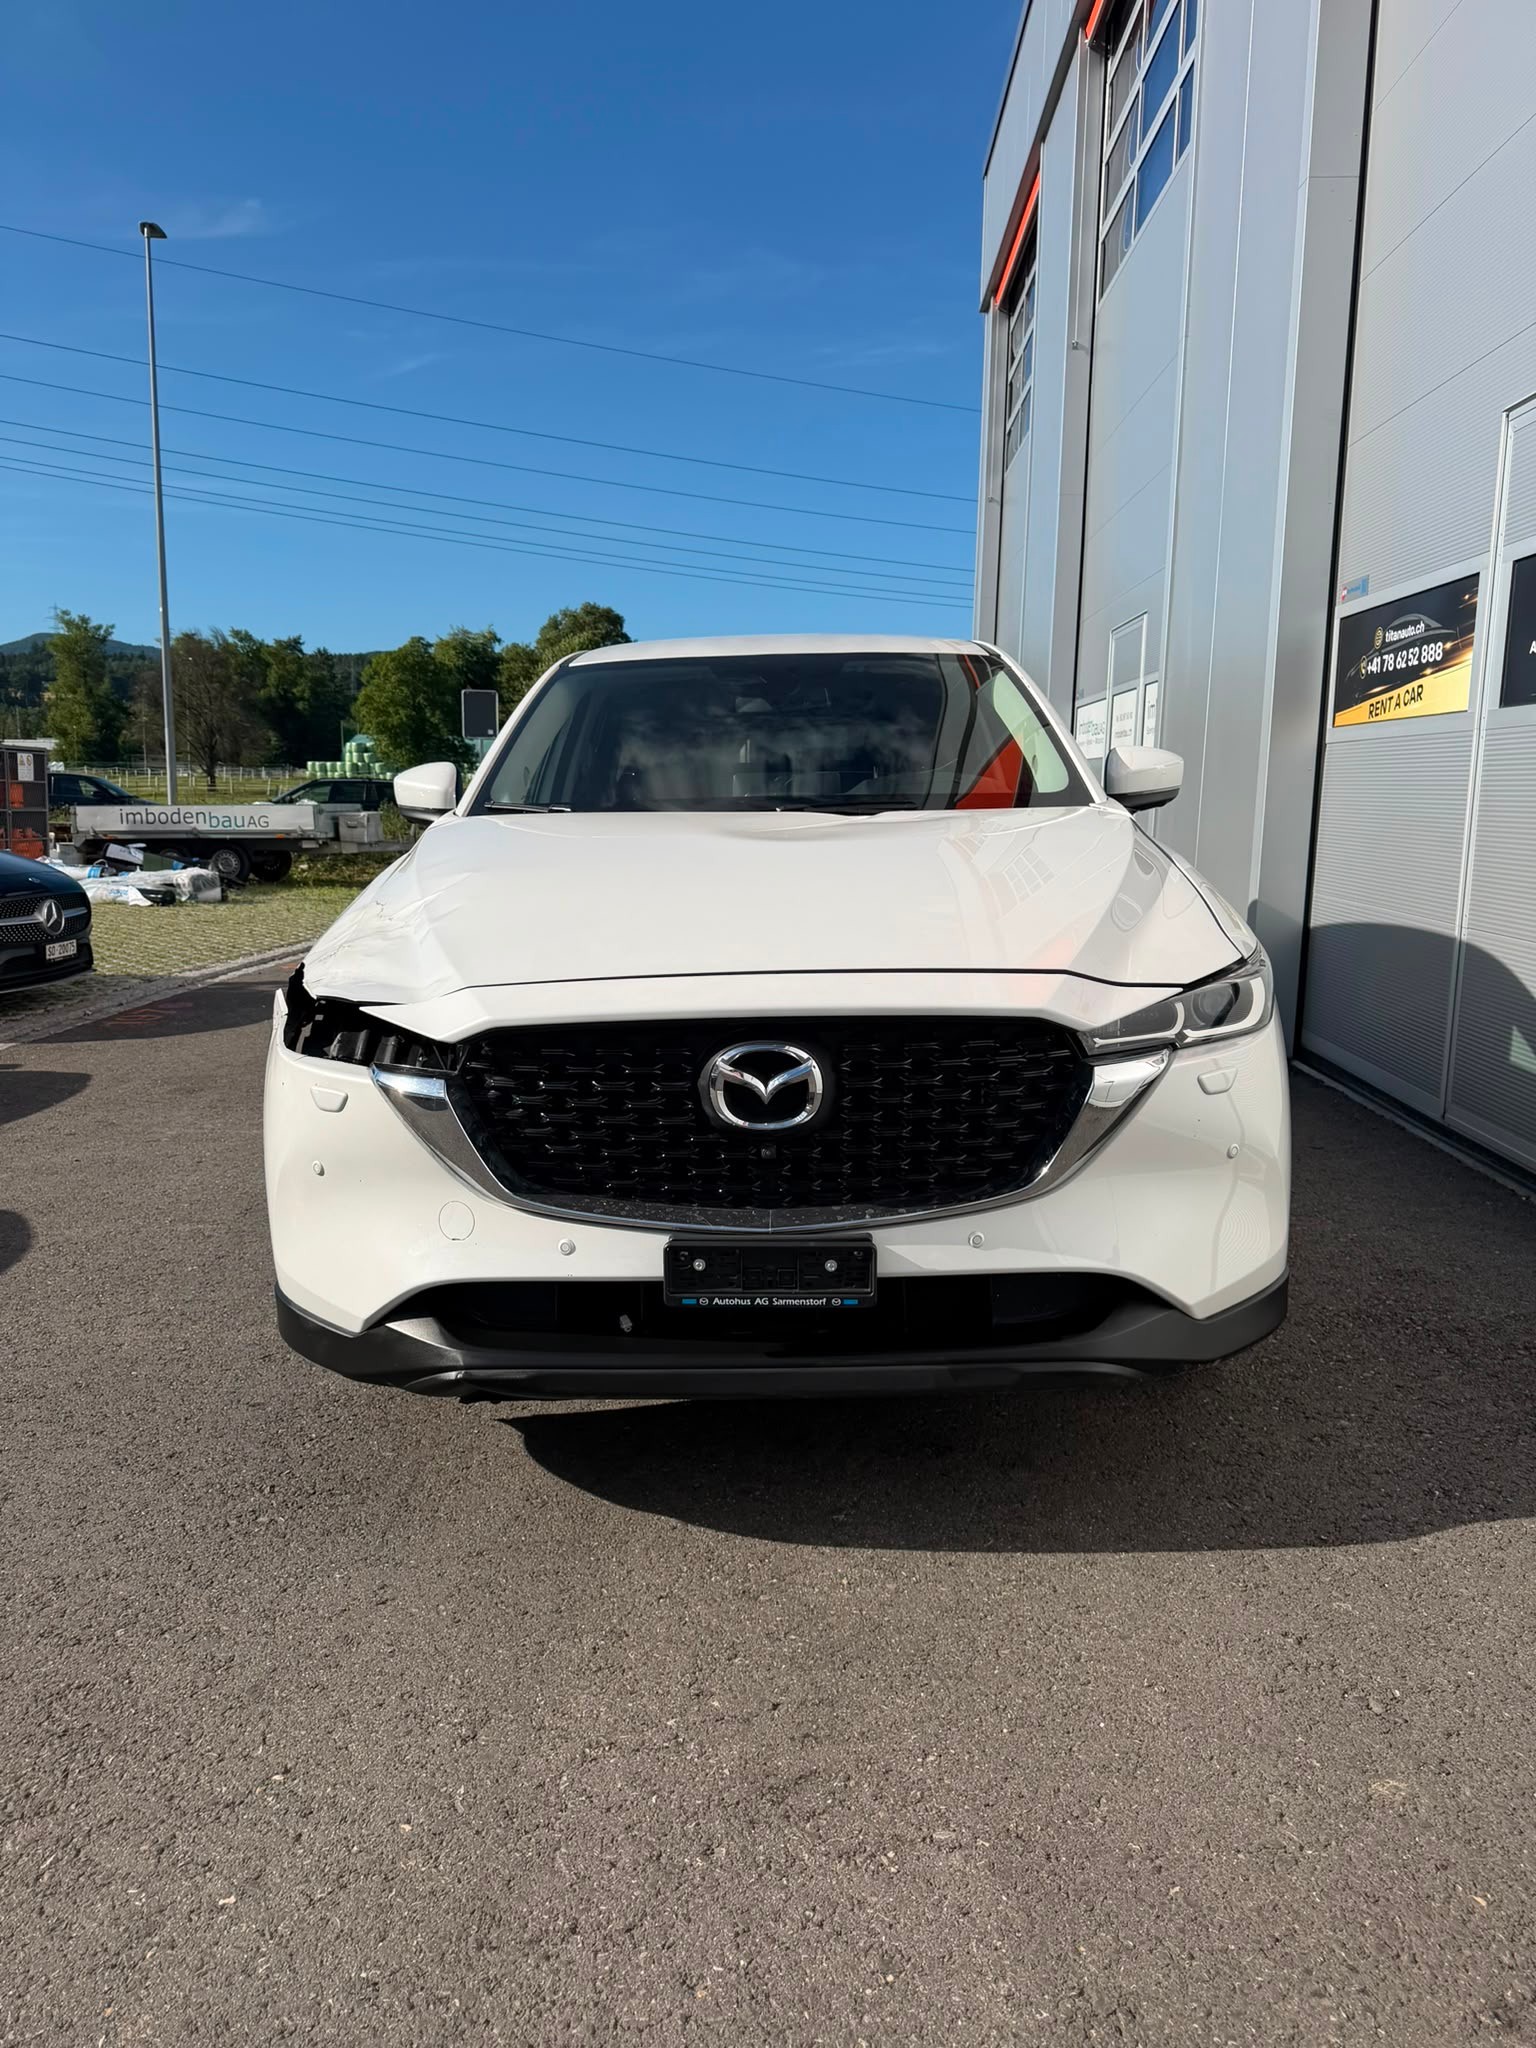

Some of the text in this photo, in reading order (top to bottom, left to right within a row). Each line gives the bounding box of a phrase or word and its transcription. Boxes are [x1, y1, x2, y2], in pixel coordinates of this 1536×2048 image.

[1385, 621, 1425, 642] titanauto.ch
[1367, 656, 1381, 674] +41
[1383, 653, 1394, 672] 78
[1421, 641, 1443, 664] 888
[1368, 684, 1424, 719] RENT A CAR
[712, 1297, 827, 1306] Autohus AG Sarmenstorf
